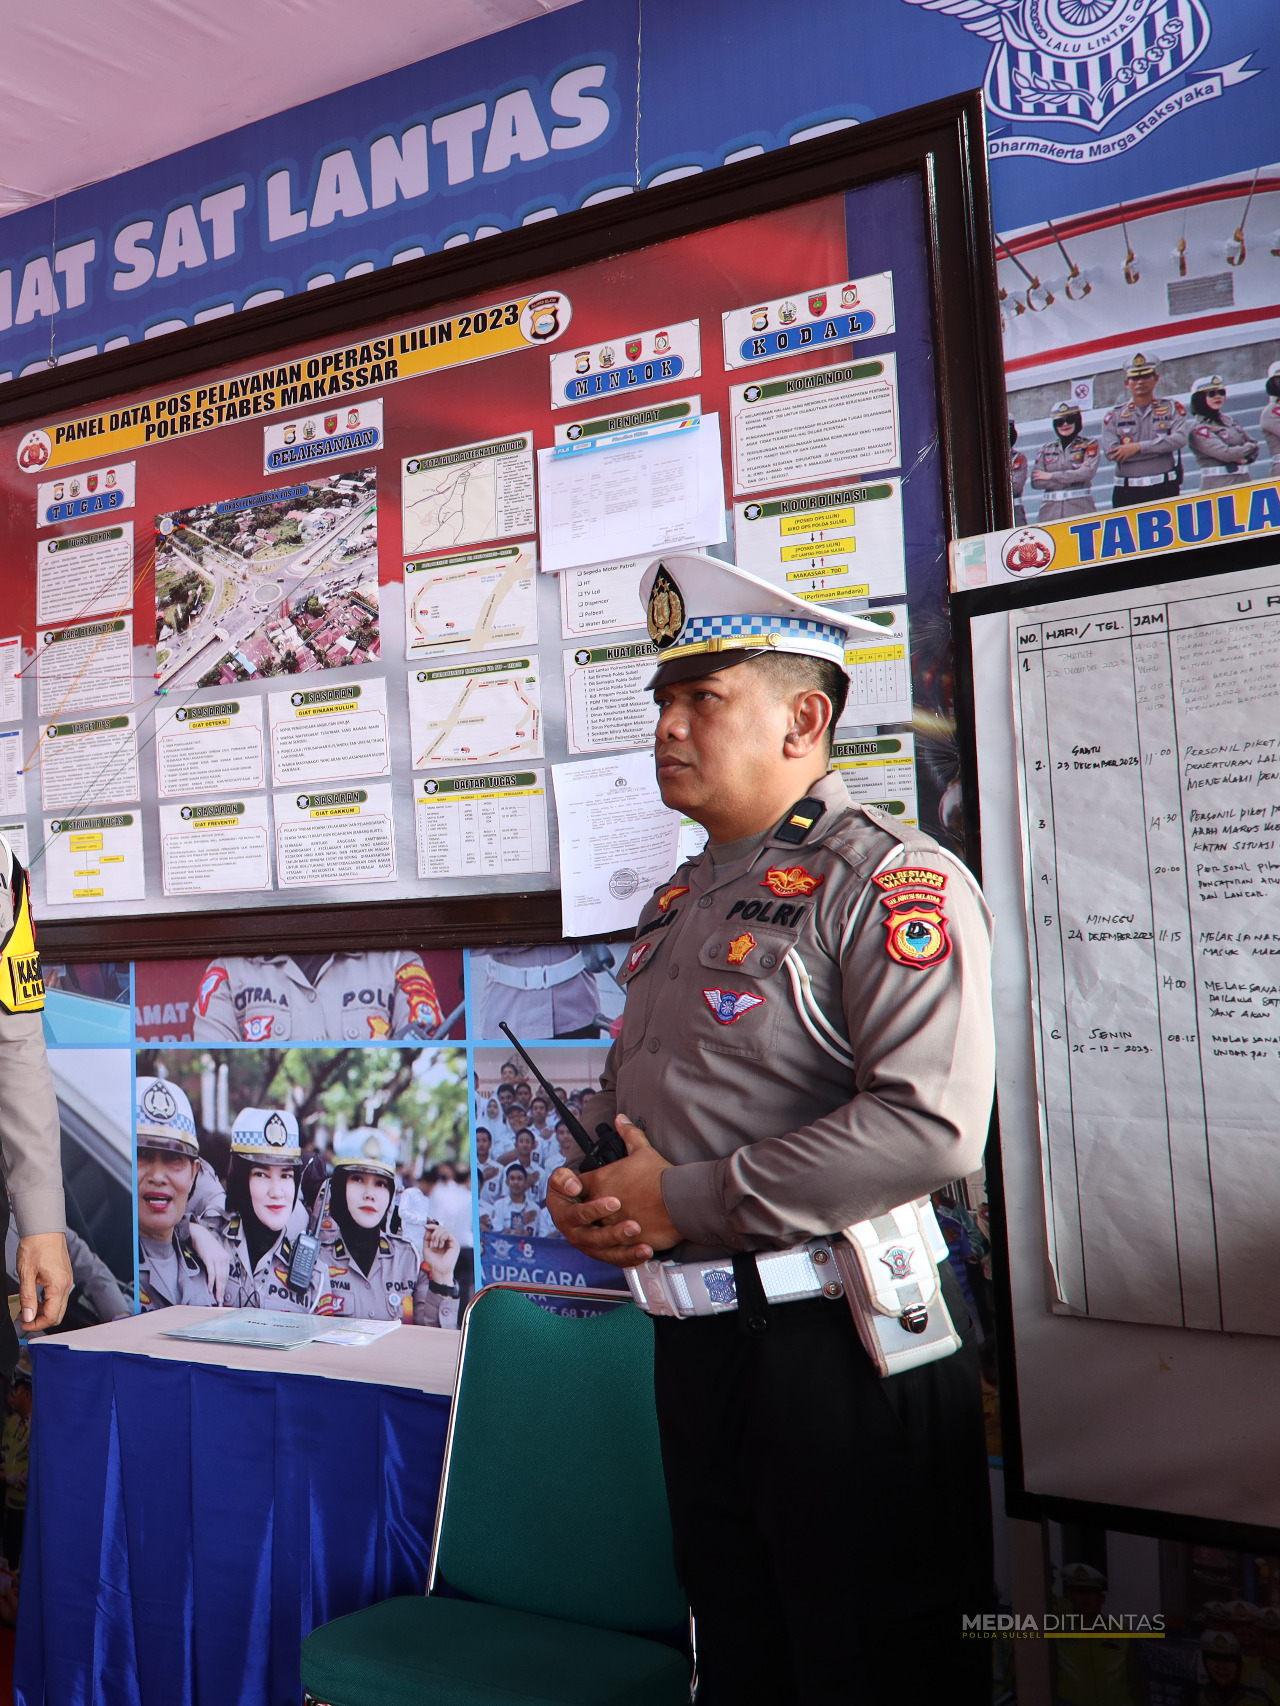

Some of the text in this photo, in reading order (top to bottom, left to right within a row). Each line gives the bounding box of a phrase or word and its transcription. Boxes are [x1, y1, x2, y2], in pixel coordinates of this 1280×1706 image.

[1045, 14, 1135, 53] LALU LINTAS
[989, 84, 1214, 160] Dharmakerta Marga Raksyaka
[113, 184, 245, 292] SAT
[266, 64, 611, 242] LANTAS
[753, 317, 861, 355] KODAL
[55, 303, 519, 445] PANEL DATA POS PELAYANAN OPERASI LILIN 2023
[576, 360, 672, 396] MINLOK
[787, 369, 853, 393] KOMANDO
[145, 361, 398, 442] POLRESTABES MAKASSAR
[608, 410, 660, 431] RENGIAT
[272, 431, 374, 467] PELAKSANAAN
[440, 454, 458, 465] JALUR
[459, 446, 498, 461] ALTERNATIF
[499, 440, 524, 452] MUDIK
[52, 494, 118, 520] TUGAS
[781, 489, 867, 513] KOORDINASI
[812, 521, 829, 529] POLDA
[830, 519, 847, 527] SULSEL
[1070, 486, 1280, 562] TABULA
[68, 531, 111, 547] TUGAS POKOK
[603, 564, 619, 572] Motor
[619, 562, 637, 570] Patroli
[793, 569, 826, 579] MAKASSAR
[804, 587, 863, 601] (Perlimaan Bandara)
[62, 622, 115, 638] CARA BERTINDAK
[1019, 633, 1038, 645] NO.
[1133, 613, 1164, 627] JAM
[1176, 624, 1255, 643] PERSONIL PIKET
[607, 646, 632, 659] KUAT
[1023, 658, 1031, 672] 1
[308, 686, 354, 703] SASARAN
[191, 704, 233, 718] SASARAN
[298, 704, 354, 717] GIAT BINAAN SULUH
[72, 719, 110, 733] TARGET OPS
[192, 721, 204, 729] GIAT
[838, 742, 877, 755] PENTING
[1183, 739, 1275, 760] PERSONIL PIKET
[1057, 762, 1069, 770] 23
[454, 776, 516, 791] DAFTAR TUGAS
[314, 791, 360, 806] SASARAN
[196, 803, 238, 817] SASARAN
[315, 807, 355, 817] GIAT GAKKUM
[69, 816, 124, 830] STRUKTUR TUGAS
[194, 818, 236, 829] GIAT PREVENTIF
[1038, 819, 1047, 829] 3
[1189, 808, 1236, 823] PERSONIL
[1191, 825, 1259, 837] ARAH MAROS
[1193, 841, 1275, 853] KATAN SITUASI
[878, 870, 944, 884] POLRESTABES
[883, 876, 942, 888] MAKASSAR
[887, 892, 942, 905] SULAWESI SELATAN
[1200, 892, 1218, 901] DAN
[726, 900, 805, 927] POLRI
[1043, 914, 1135, 926] 5 MINGGU
[1068, 930, 1083, 942] 24
[1241, 1010, 1271, 1018] AKAN
[1088, 1029, 1133, 1040] SENIN
[492, 1265, 587, 1288] UPACARA
